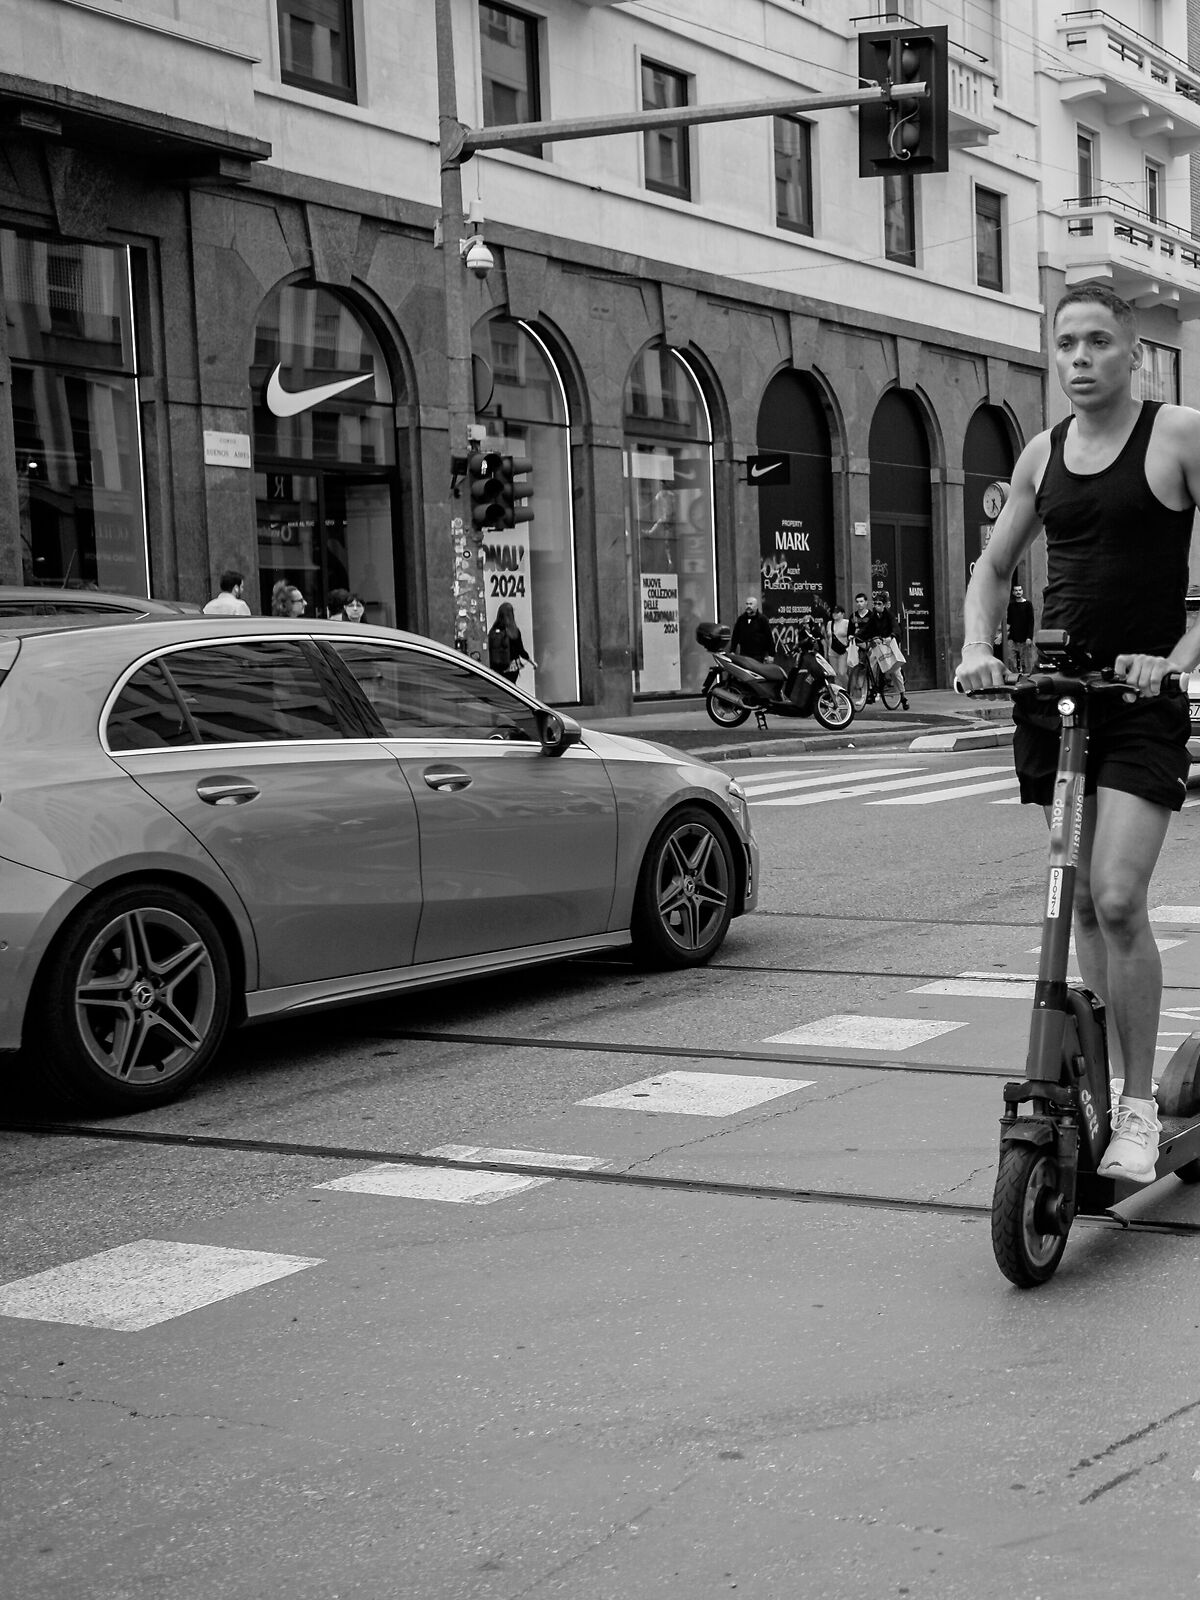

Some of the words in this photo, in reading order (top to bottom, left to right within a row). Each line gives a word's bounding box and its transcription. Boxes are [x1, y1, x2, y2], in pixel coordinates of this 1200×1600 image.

[781, 520, 803, 528] PROPERTY
[775, 531, 810, 552] MARK
[490, 575, 526, 598] 2024
[642, 578, 662, 588] NUOVE
[647, 589, 678, 599] COLLEZIONI
[643, 600, 659, 610] DELLE
[663, 624, 679, 634] 2024
[1052, 798, 1064, 829] dott
[1081, 1089, 1099, 1140] dott
